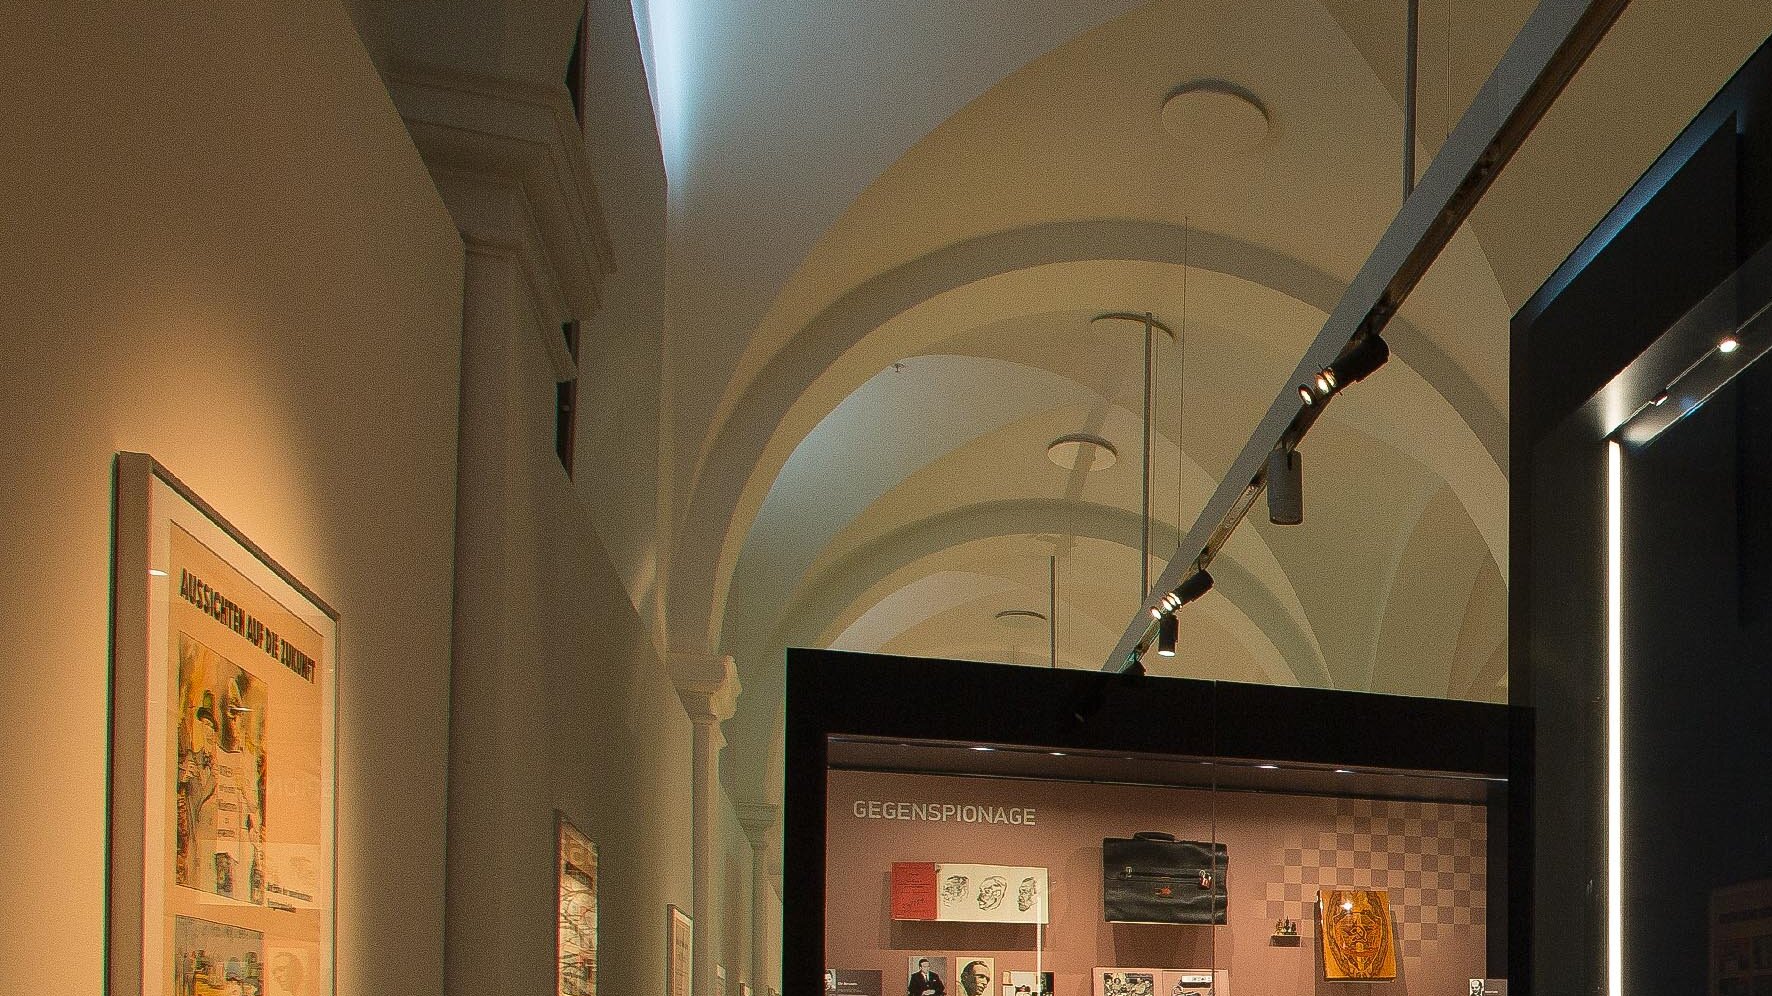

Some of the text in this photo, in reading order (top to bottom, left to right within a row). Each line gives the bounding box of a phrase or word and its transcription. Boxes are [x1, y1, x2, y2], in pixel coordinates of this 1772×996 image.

[180, 567, 315, 685] AUSSICHTEN AUF DIE ZUKUNFT
[853, 800, 1036, 826] GEGENSPIONAGE
